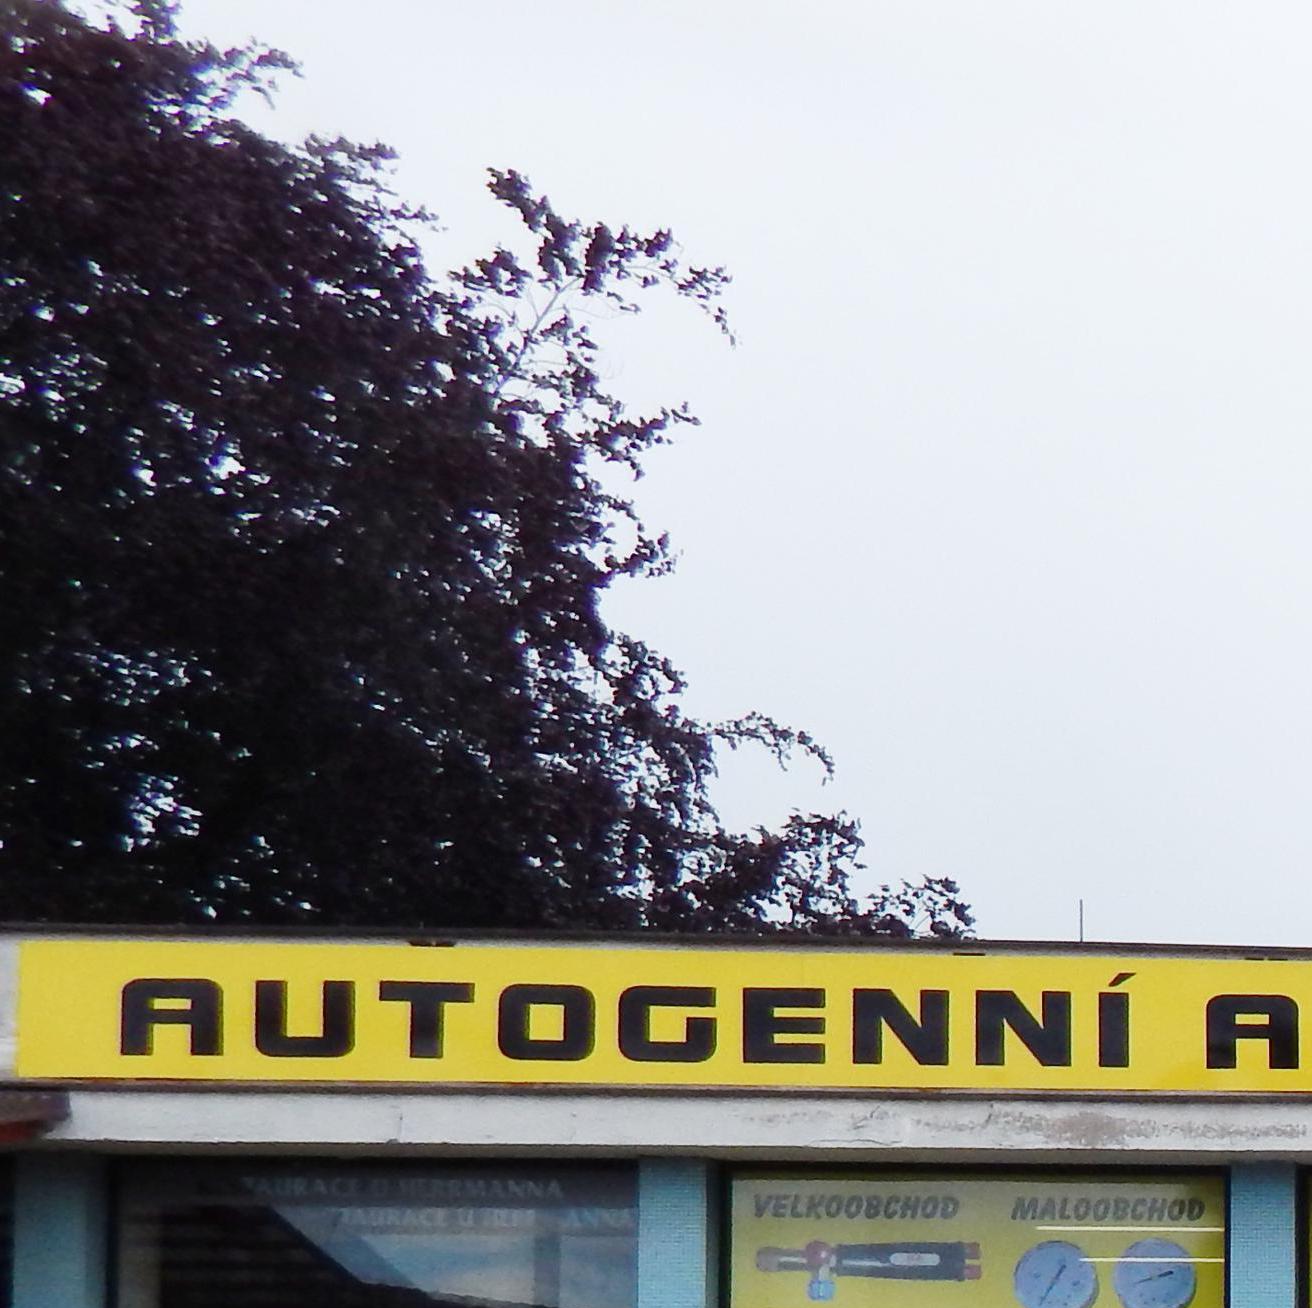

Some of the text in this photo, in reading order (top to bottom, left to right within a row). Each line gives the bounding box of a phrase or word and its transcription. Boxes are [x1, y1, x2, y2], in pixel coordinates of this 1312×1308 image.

[120, 972, 1136, 1068] AUTOGENNÍ
[1206, 994, 1299, 1069] A
[752, 1193, 1206, 1222] VELKOOBCHOD MALOOBCHOD
